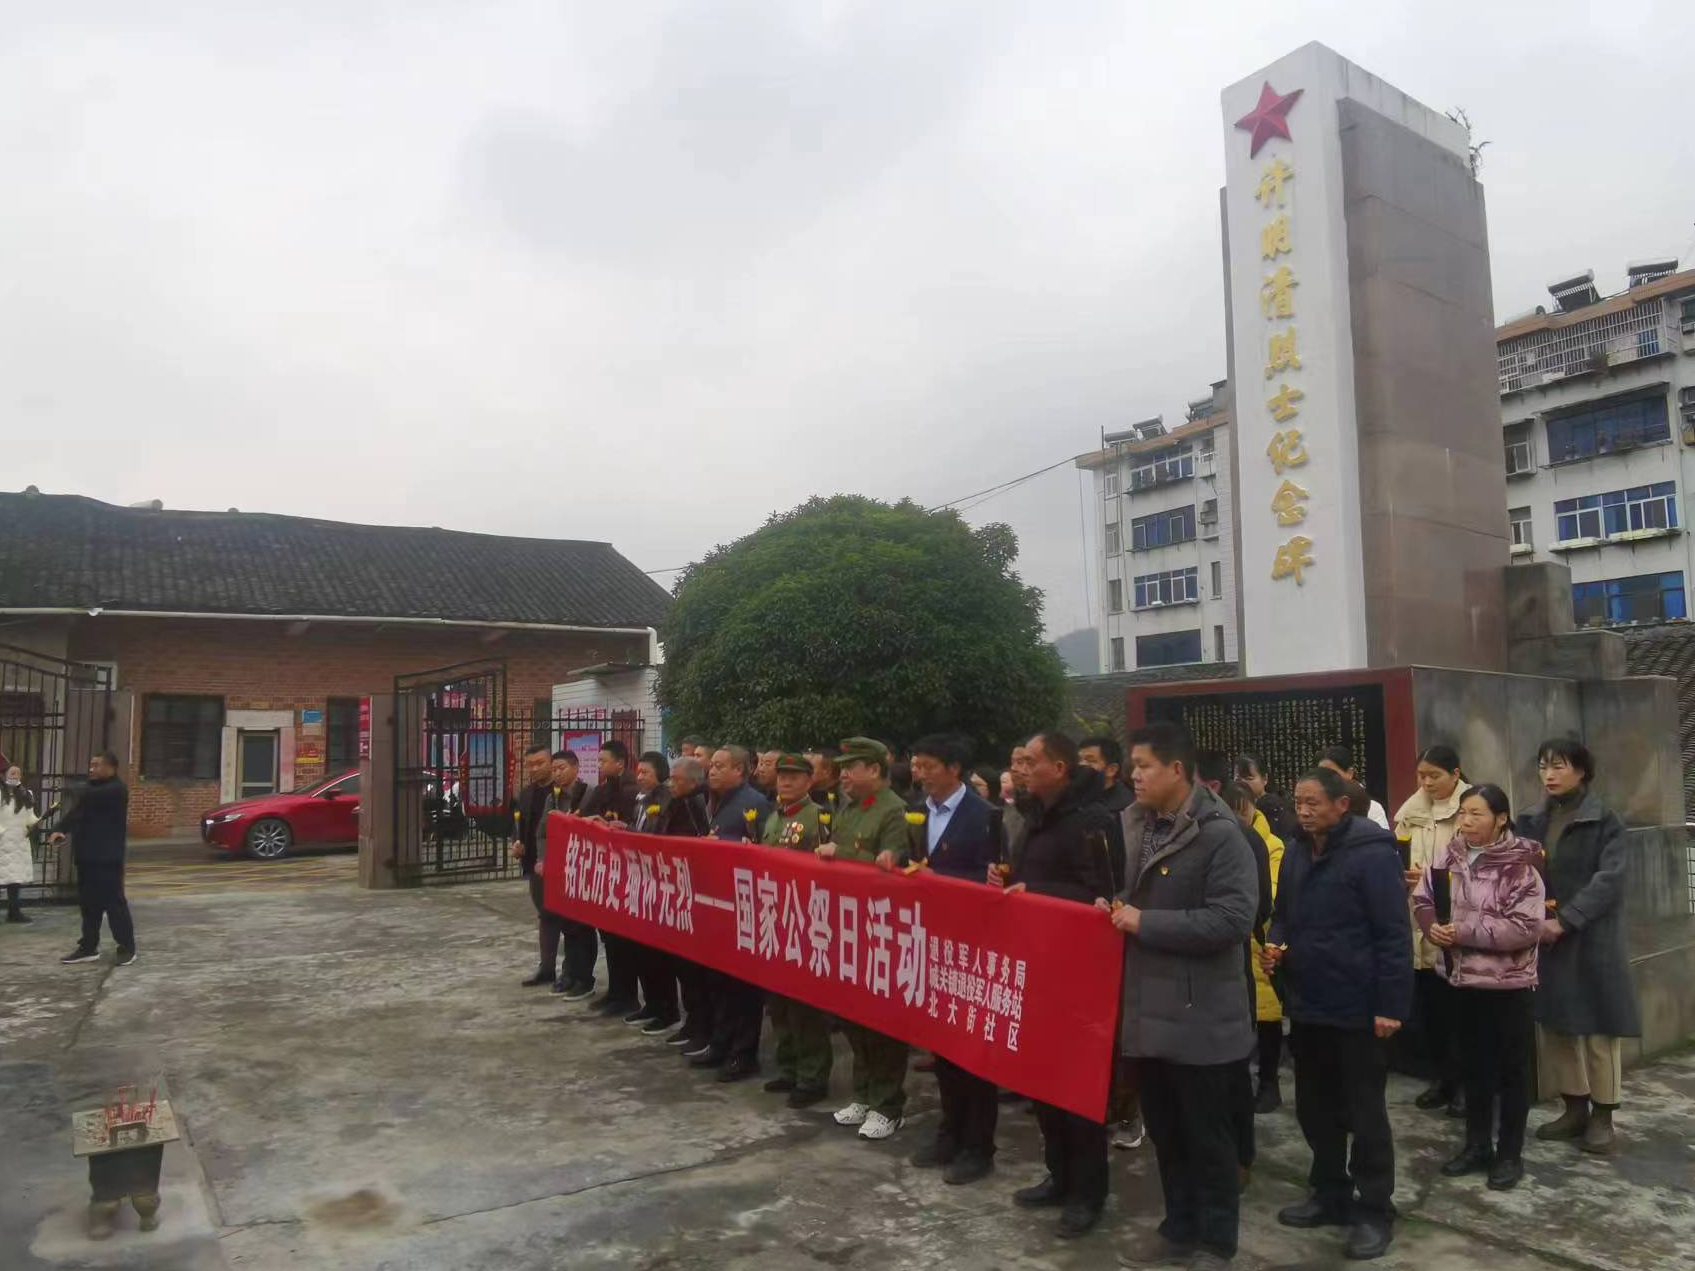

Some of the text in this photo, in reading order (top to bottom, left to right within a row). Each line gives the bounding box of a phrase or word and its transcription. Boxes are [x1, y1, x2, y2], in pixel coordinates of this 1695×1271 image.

[930, 936, 1026, 989] 退役军人事务局
[930, 962, 1022, 1021] 城关镇退役军人服务站
[928, 991, 1020, 1051] 北大街社区
